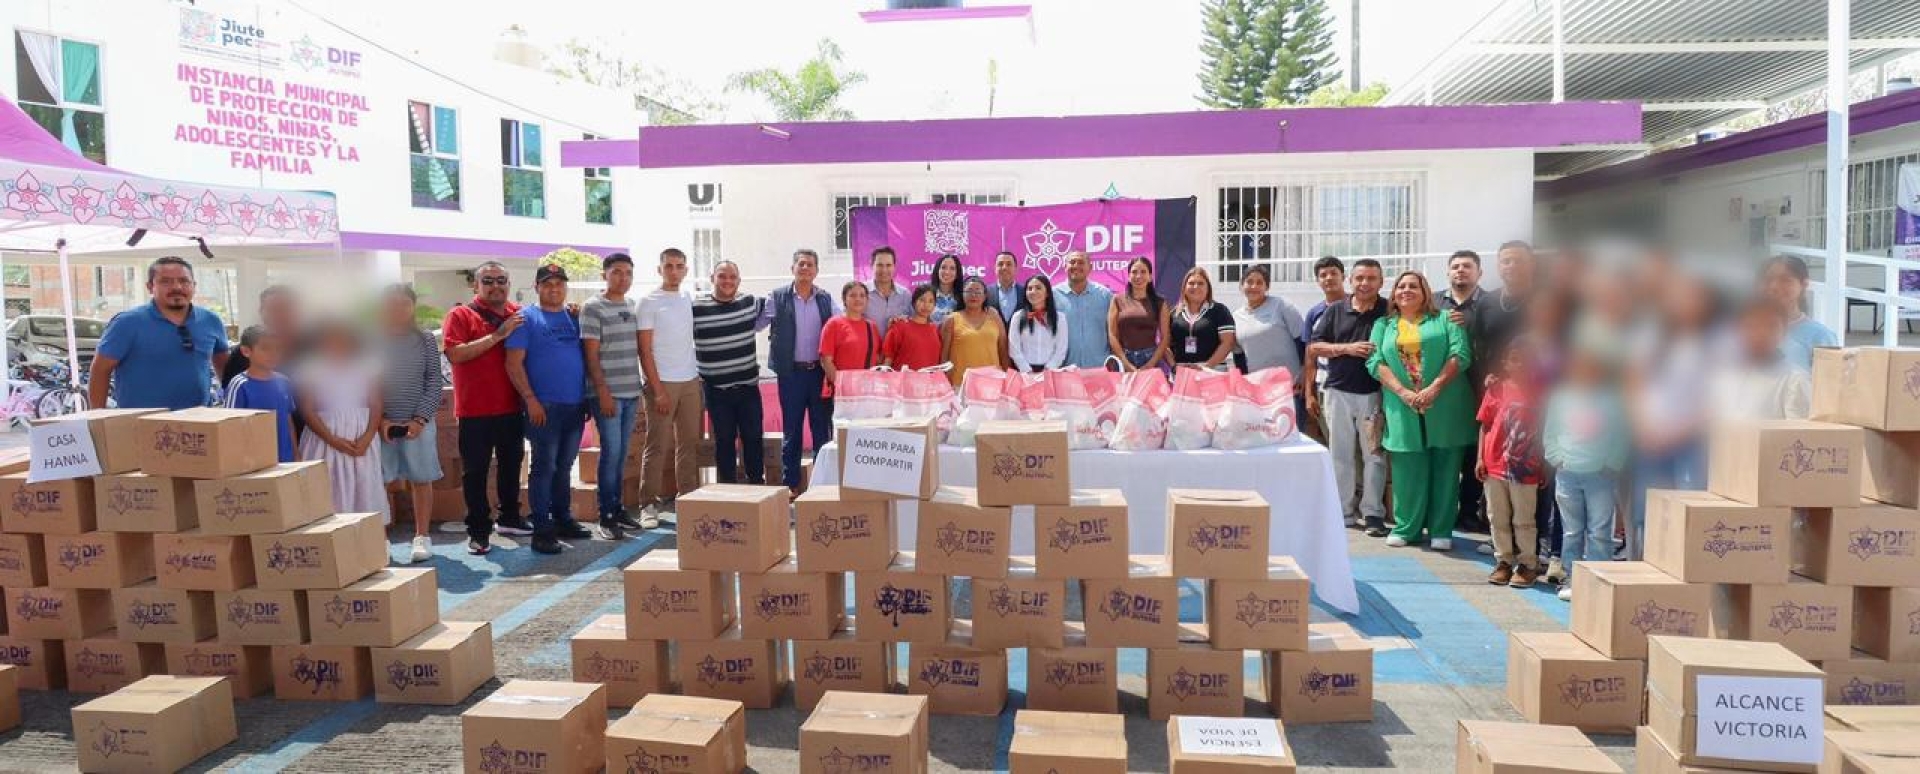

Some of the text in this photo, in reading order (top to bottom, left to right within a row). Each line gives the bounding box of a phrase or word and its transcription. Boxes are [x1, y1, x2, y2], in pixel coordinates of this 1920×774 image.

[220, 18, 265, 38] Jiute
[222, 33, 253, 47] pec
[327, 48, 361, 67] DIF
[177, 63, 371, 112] INSTANCIA MUNICIPAL
[189, 86, 215, 105] DE
[338, 110, 358, 127] DE
[174, 125, 360, 162] ADOLESCENTES Y LA
[230, 151, 313, 175] FAMILIA
[1085, 224, 1144, 253] DIF
[911, 260, 987, 277] Jiuec
[47, 433, 77, 447] CASA
[856, 437, 916, 455] AMOR PARA
[44, 453, 89, 469] HANNA
[854, 454, 913, 471] COMPARTIR
[36, 491, 61, 503] DIF
[840, 514, 868, 530] DIF
[1079, 518, 1108, 534] DIF
[966, 530, 996, 544] DIF
[254, 602, 280, 615] DIF
[1133, 596, 1163, 612] DIF
[834, 657, 862, 670] DIF
[1077, 662, 1105, 676] DIF
[1200, 673, 1229, 688] DIF
[1715, 693, 1805, 712] ALCANCE
[1714, 721, 1807, 740] VICTORIA
